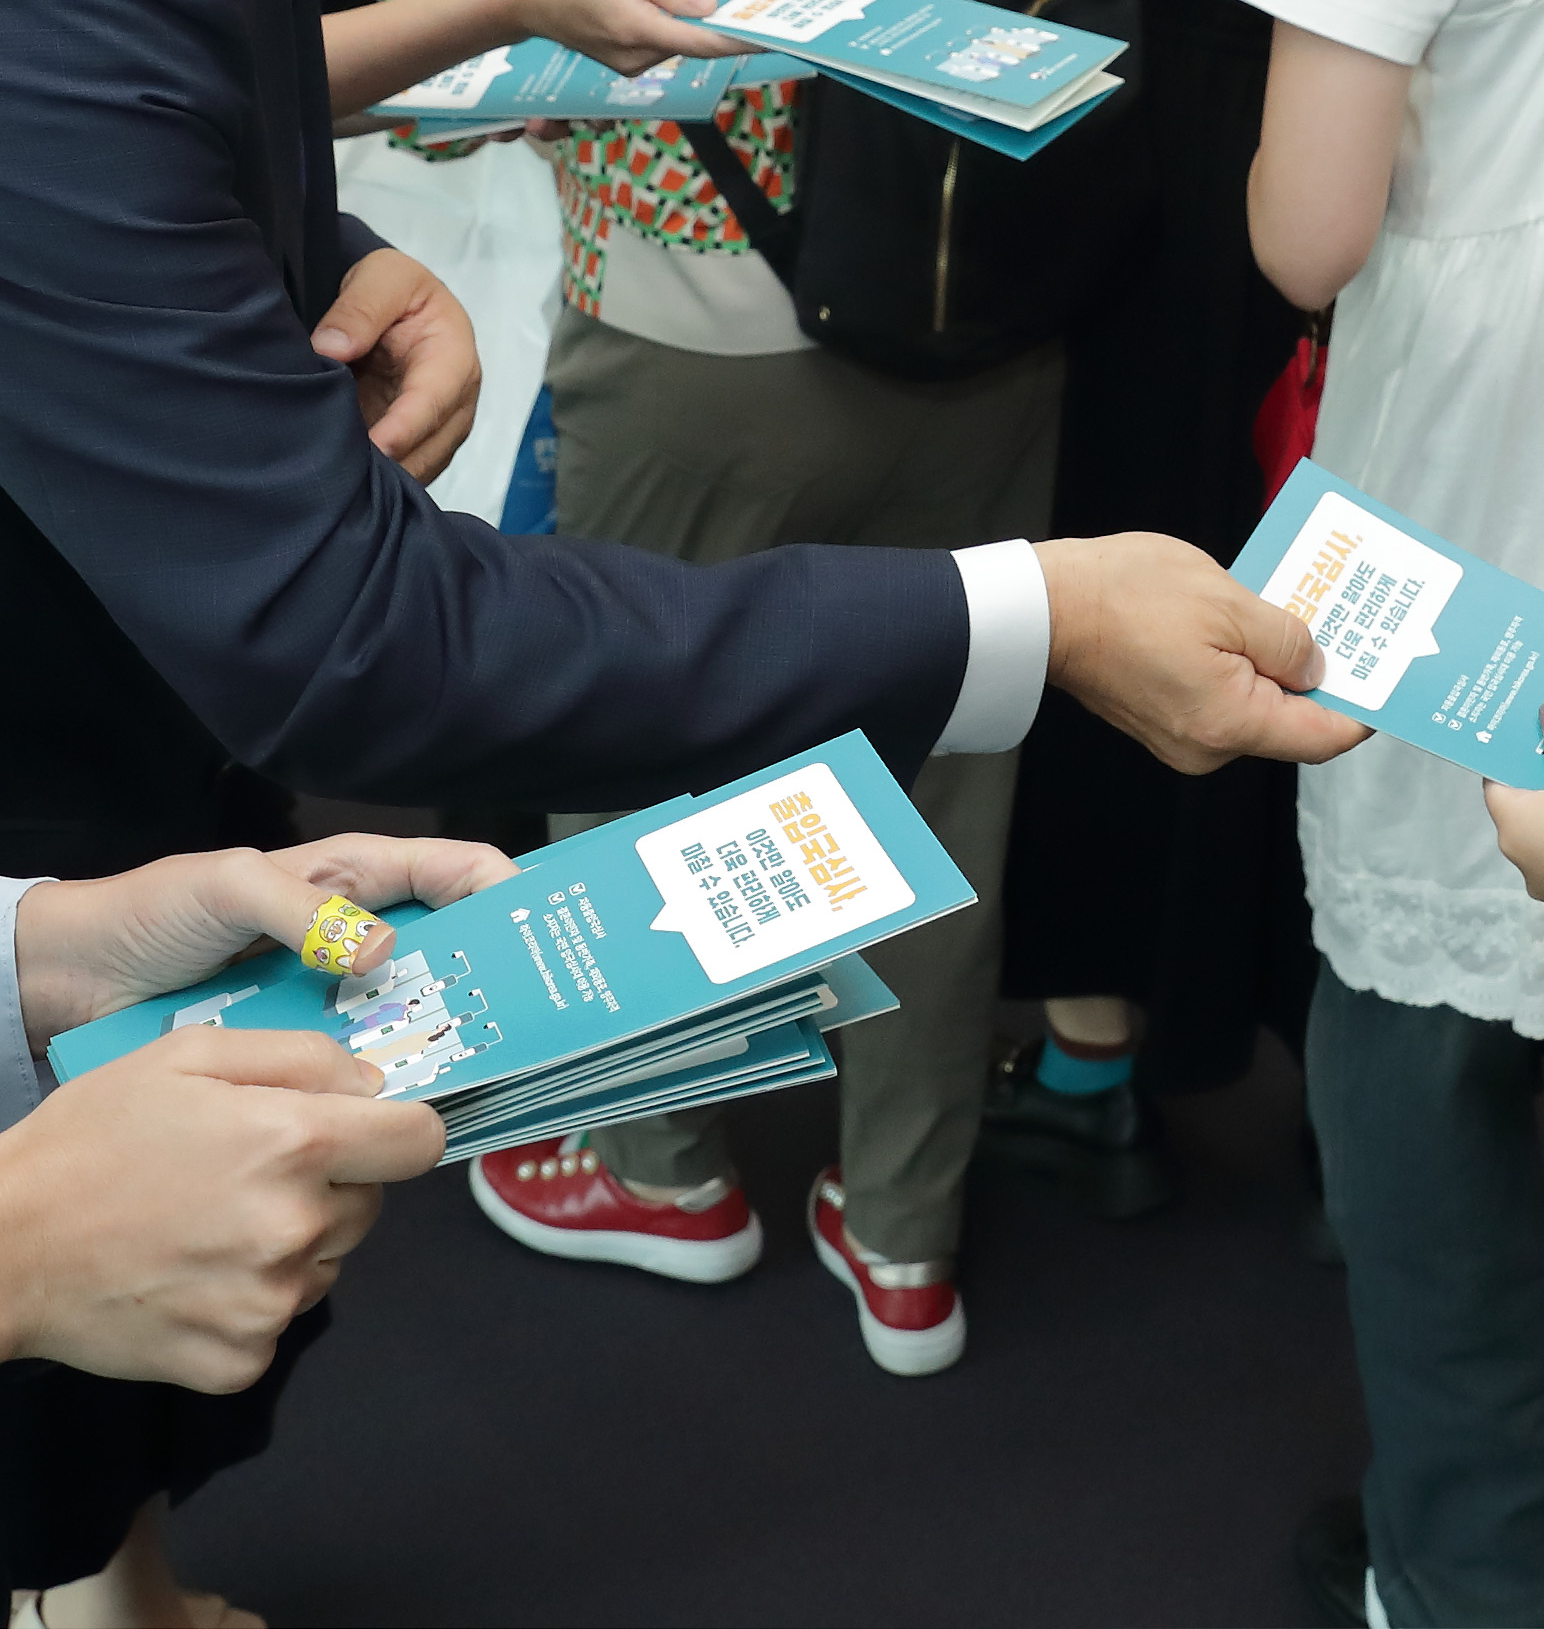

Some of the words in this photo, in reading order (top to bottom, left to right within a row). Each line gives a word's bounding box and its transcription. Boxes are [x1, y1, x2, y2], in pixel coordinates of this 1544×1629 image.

[1284, 521, 1364, 624] 입국심사,
[1314, 602, 1350, 648] 이것만
[1340, 559, 1376, 605] 알아도
[1379, 573, 1425, 634] 있습니다.
[1335, 627, 1363, 660] 더욱
[1353, 571, 1397, 630] 편리하게
[1369, 631, 1390, 652] 수
[1350, 649, 1379, 681] 마칠
[679, 841, 713, 875] 마칠
[697, 871, 723, 892] 수
[715, 840, 748, 873] 더욱
[732, 868, 781, 925] 편리하게
[744, 826, 786, 871] 이것만
[768, 867, 811, 913] 알아도
[767, 788, 867, 913] 출입국심사,
[706, 889, 756, 949] 있습니다.
